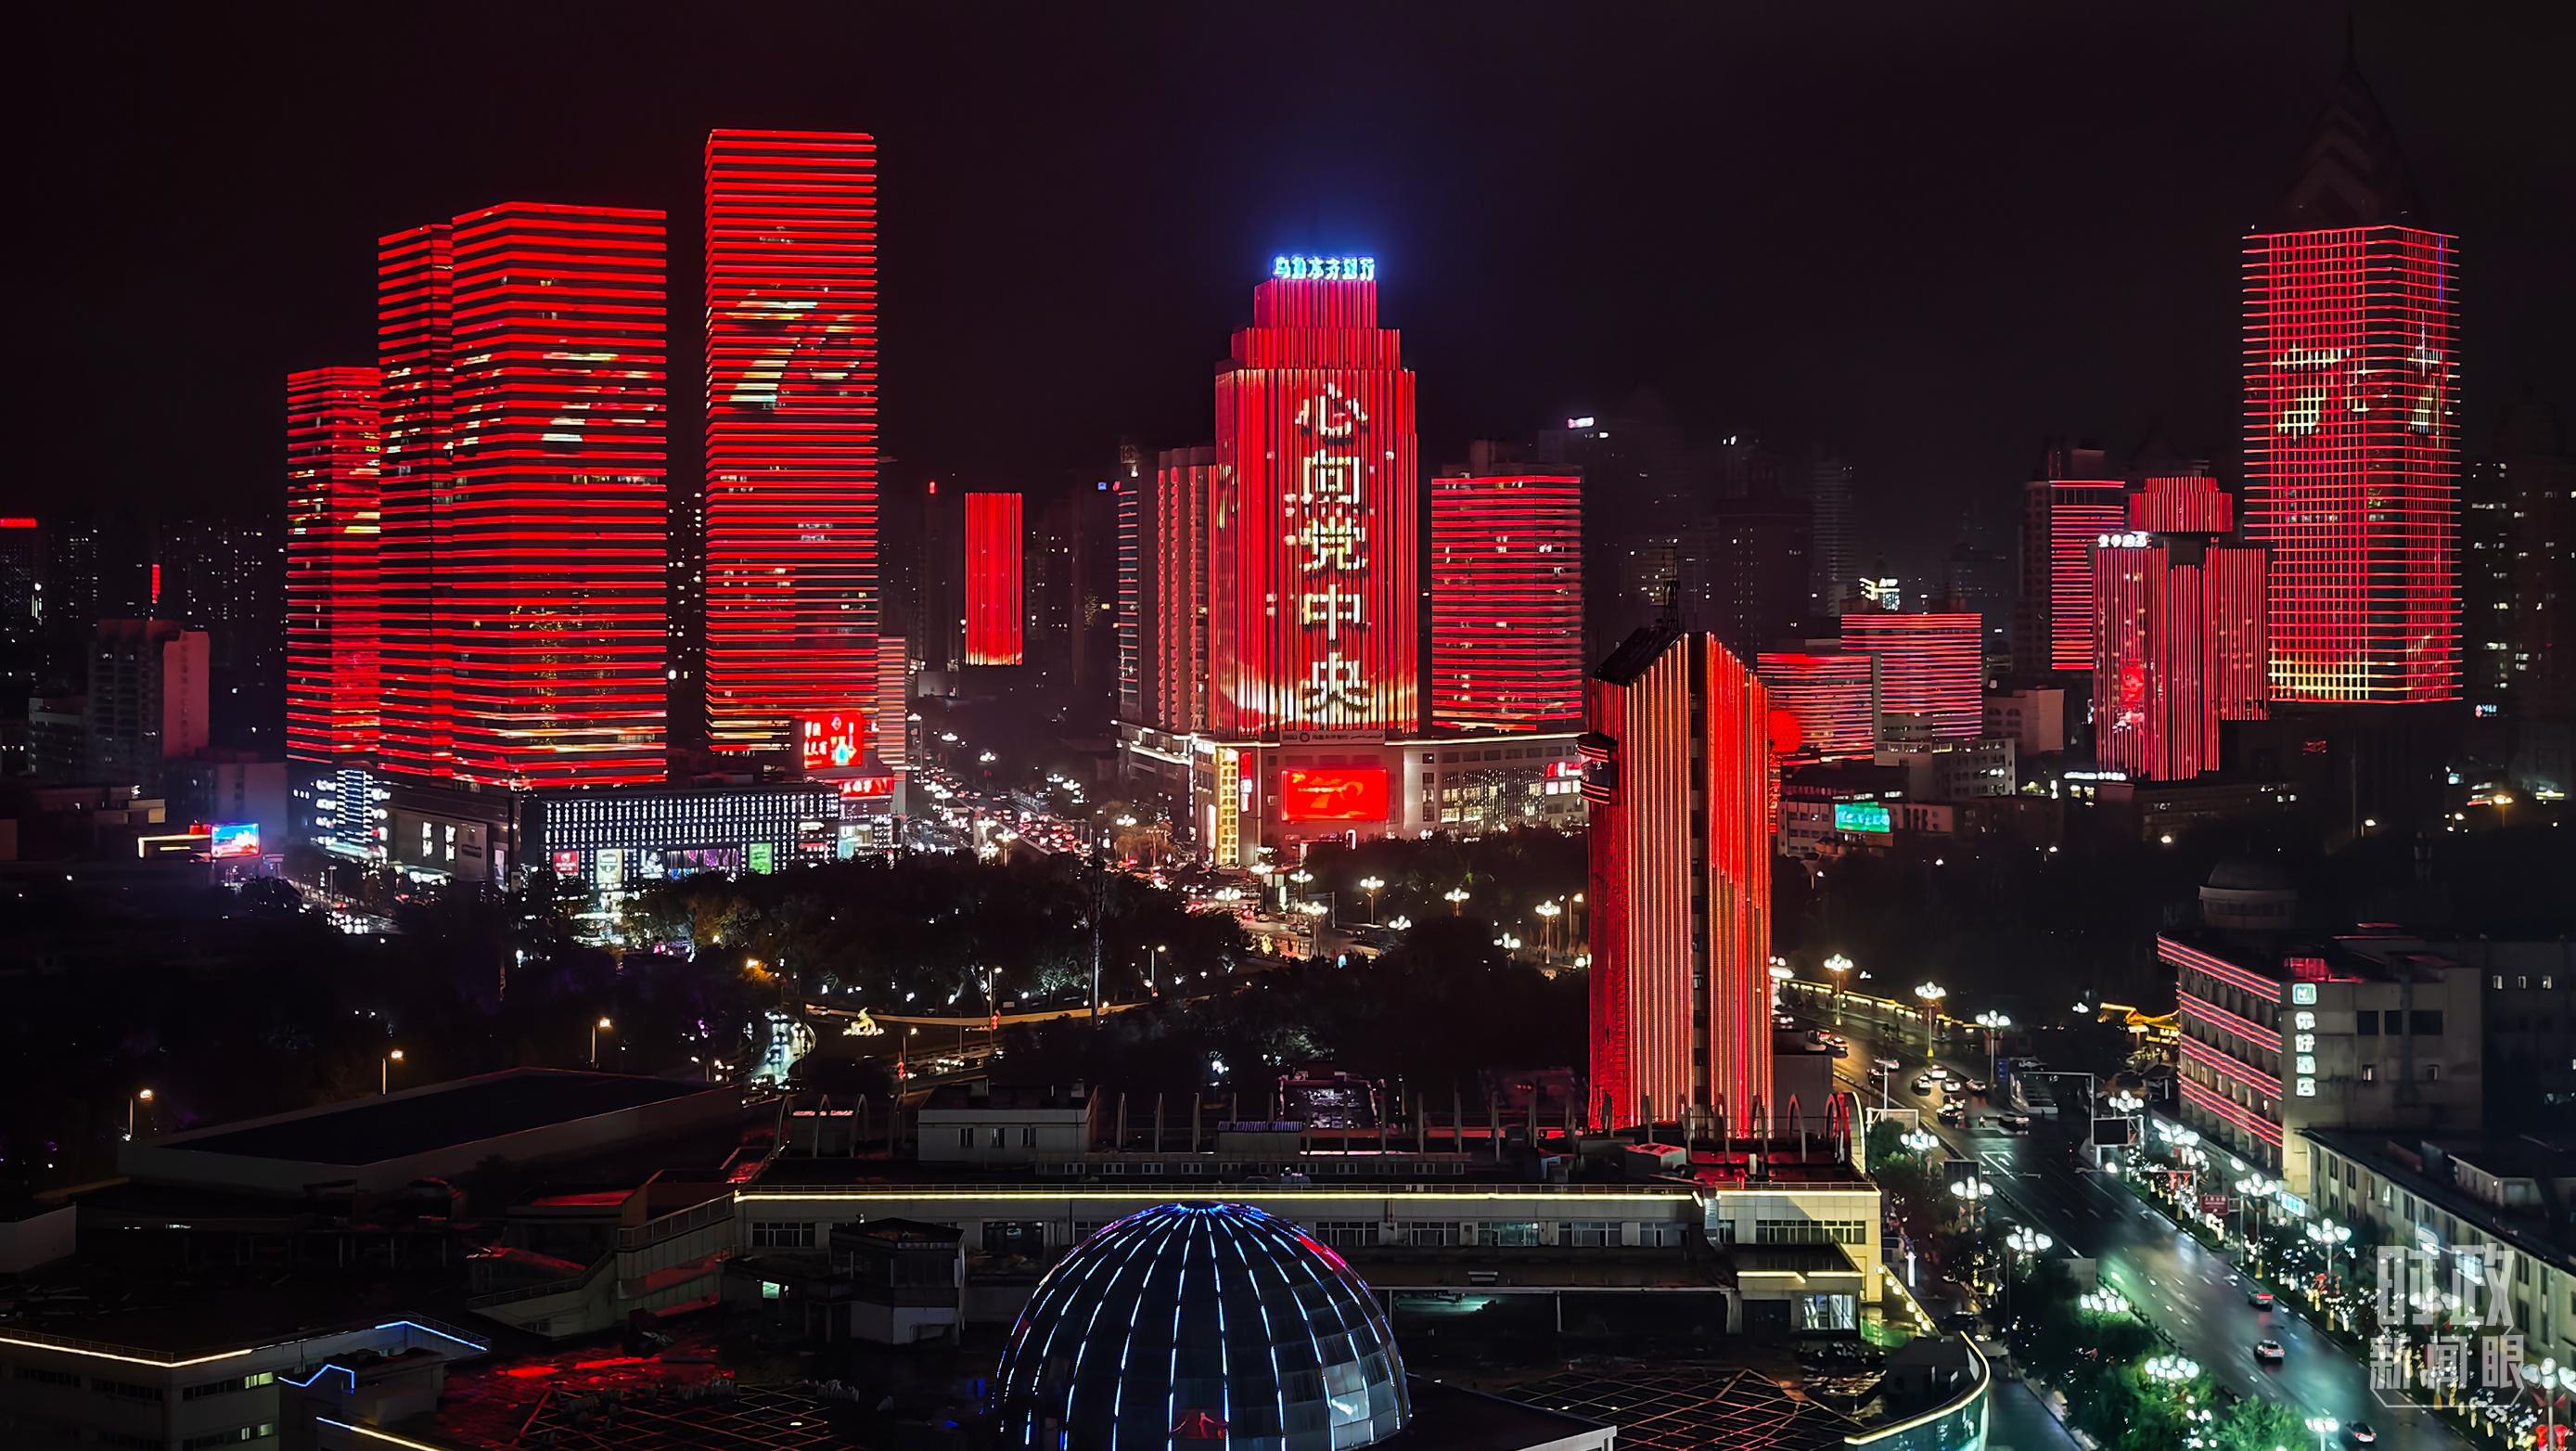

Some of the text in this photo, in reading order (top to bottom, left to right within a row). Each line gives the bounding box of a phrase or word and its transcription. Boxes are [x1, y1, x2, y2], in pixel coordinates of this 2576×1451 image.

[1273, 254, 1375, 281] 乌鲁木齐银行
[1296, 381, 1370, 721] 心向党中央
